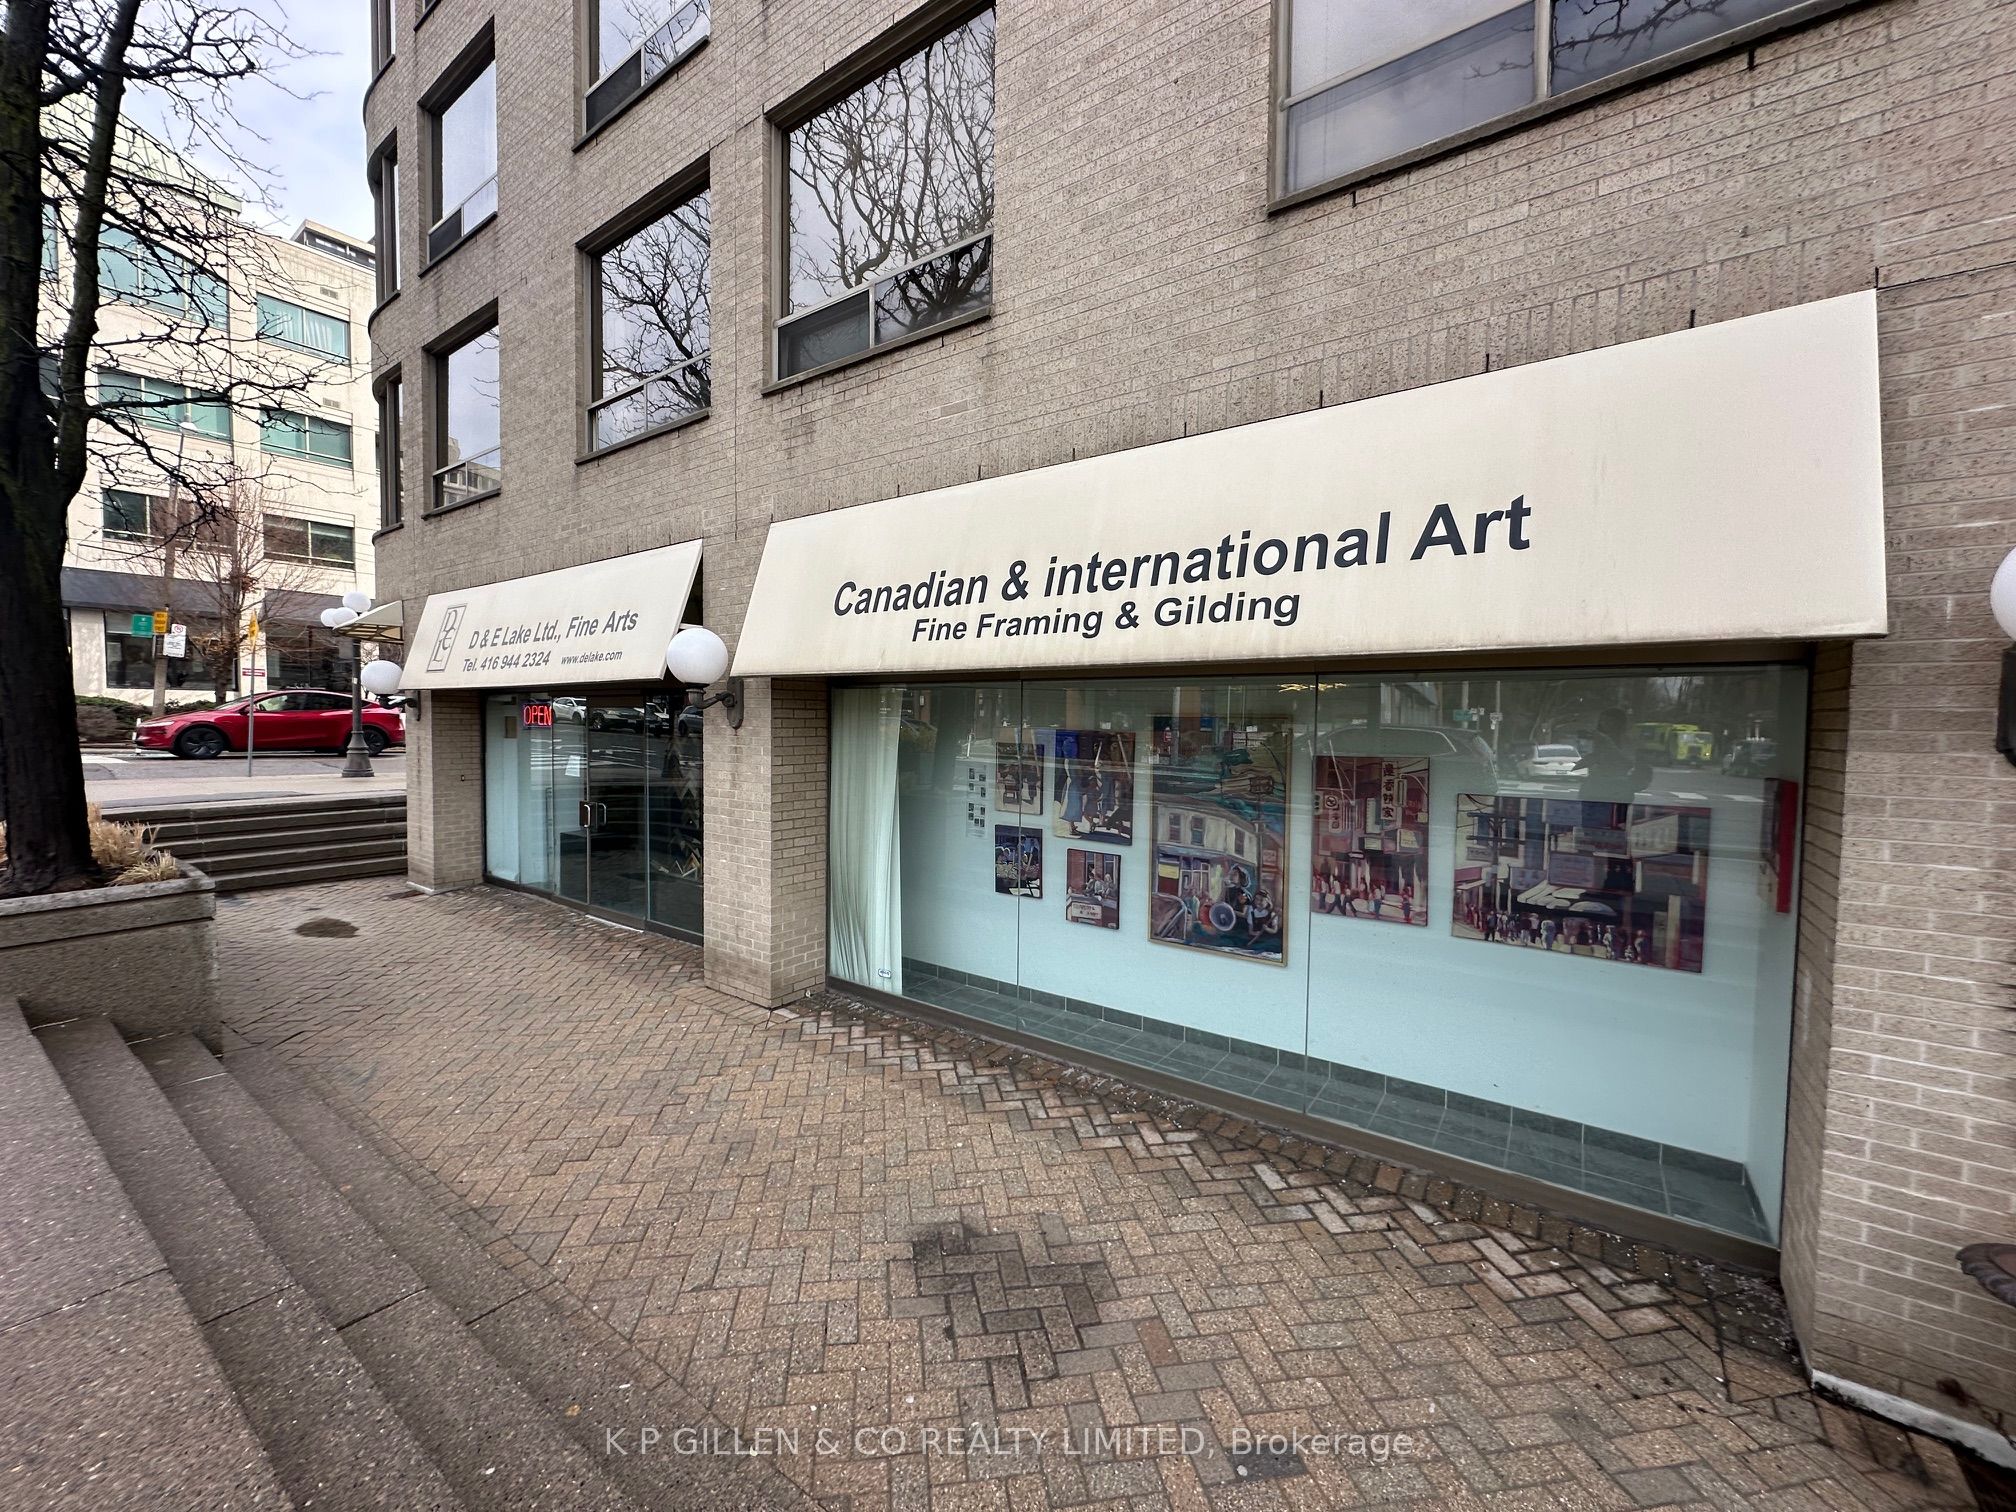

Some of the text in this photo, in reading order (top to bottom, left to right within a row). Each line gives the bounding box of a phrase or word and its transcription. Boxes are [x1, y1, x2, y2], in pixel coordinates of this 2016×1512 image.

[833, 494, 1532, 616] Canadian & international Art
[468, 609, 639, 650] D & E Lake Ltd., Fine Arts
[912, 591, 1300, 642] Fine Framing & Gilding
[462, 649, 623, 673] Tel. 416 944 2324 www.delake.com
[523, 705, 552, 726] OPEN
